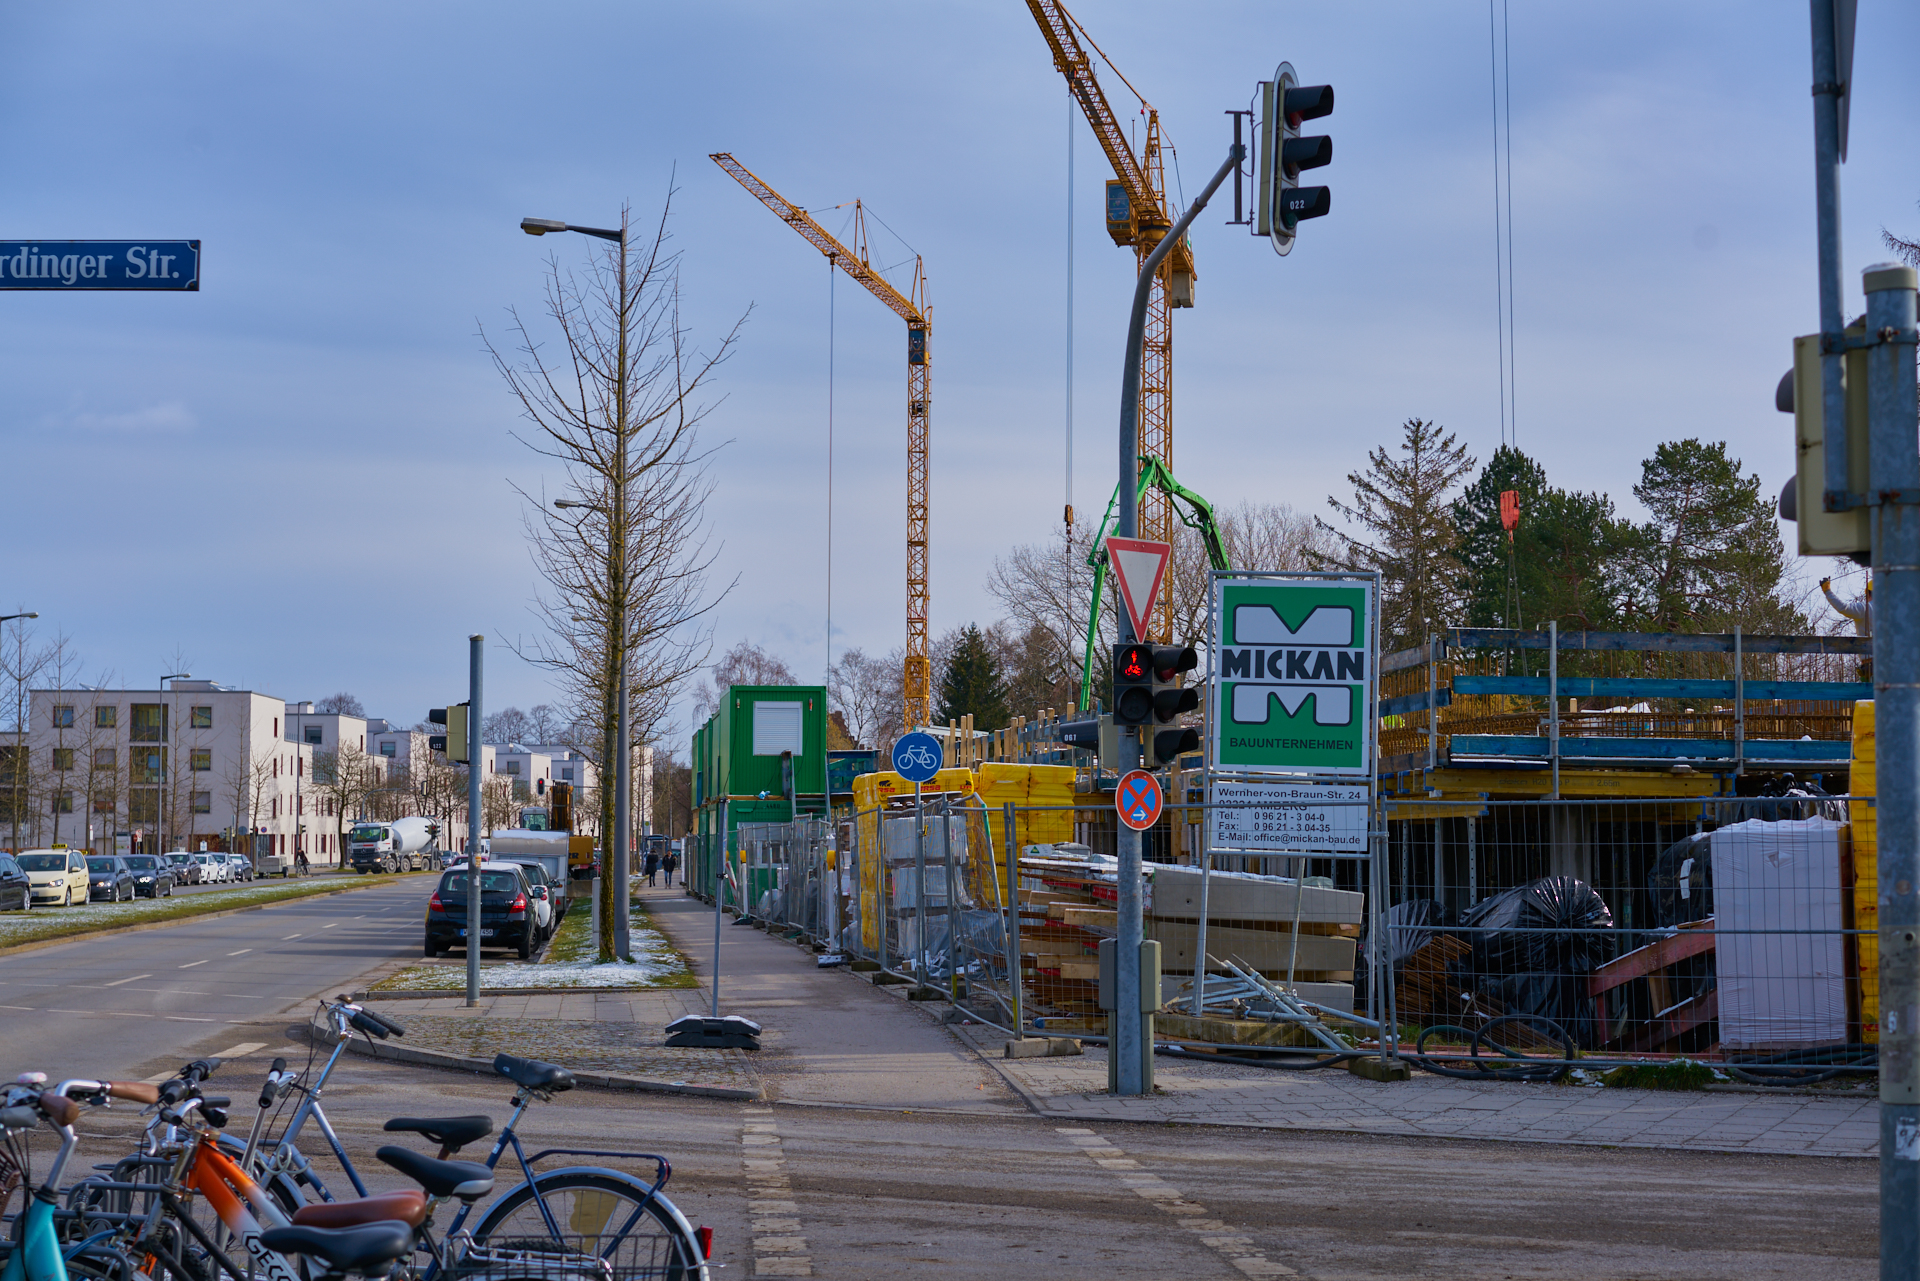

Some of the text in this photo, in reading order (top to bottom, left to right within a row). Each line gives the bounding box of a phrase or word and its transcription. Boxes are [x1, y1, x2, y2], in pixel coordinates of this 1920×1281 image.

[1289, 199, 1305, 210] 022
[126, 246, 180, 279] Str.
[1221, 649, 1364, 681] MICKAN
[1229, 737, 1353, 750] BAUUNTERNEHMEN
[1218, 788, 1361, 800] Wernher-von-Braun-Str. 24
[1218, 811, 1239, 820] Tel.:
[1254, 812, 1260, 820] 0
[1262, 812, 1274, 820] 96
[1276, 812, 1287, 821] 21
[1296, 813, 1302, 821] 3
[1305, 813, 1325, 822] 04-0
[1218, 822, 1239, 830] Fax:
[1254, 822, 1260, 831] 0
[1262, 822, 1274, 831] 96
[1276, 823, 1287, 831] 21
[1296, 823, 1302, 832] 3
[1305, 824, 1331, 832] 04-35
[1218, 832, 1361, 845] E-Mail: office@mickan-bau.de
[245, 1235, 293, 1281] GEC
